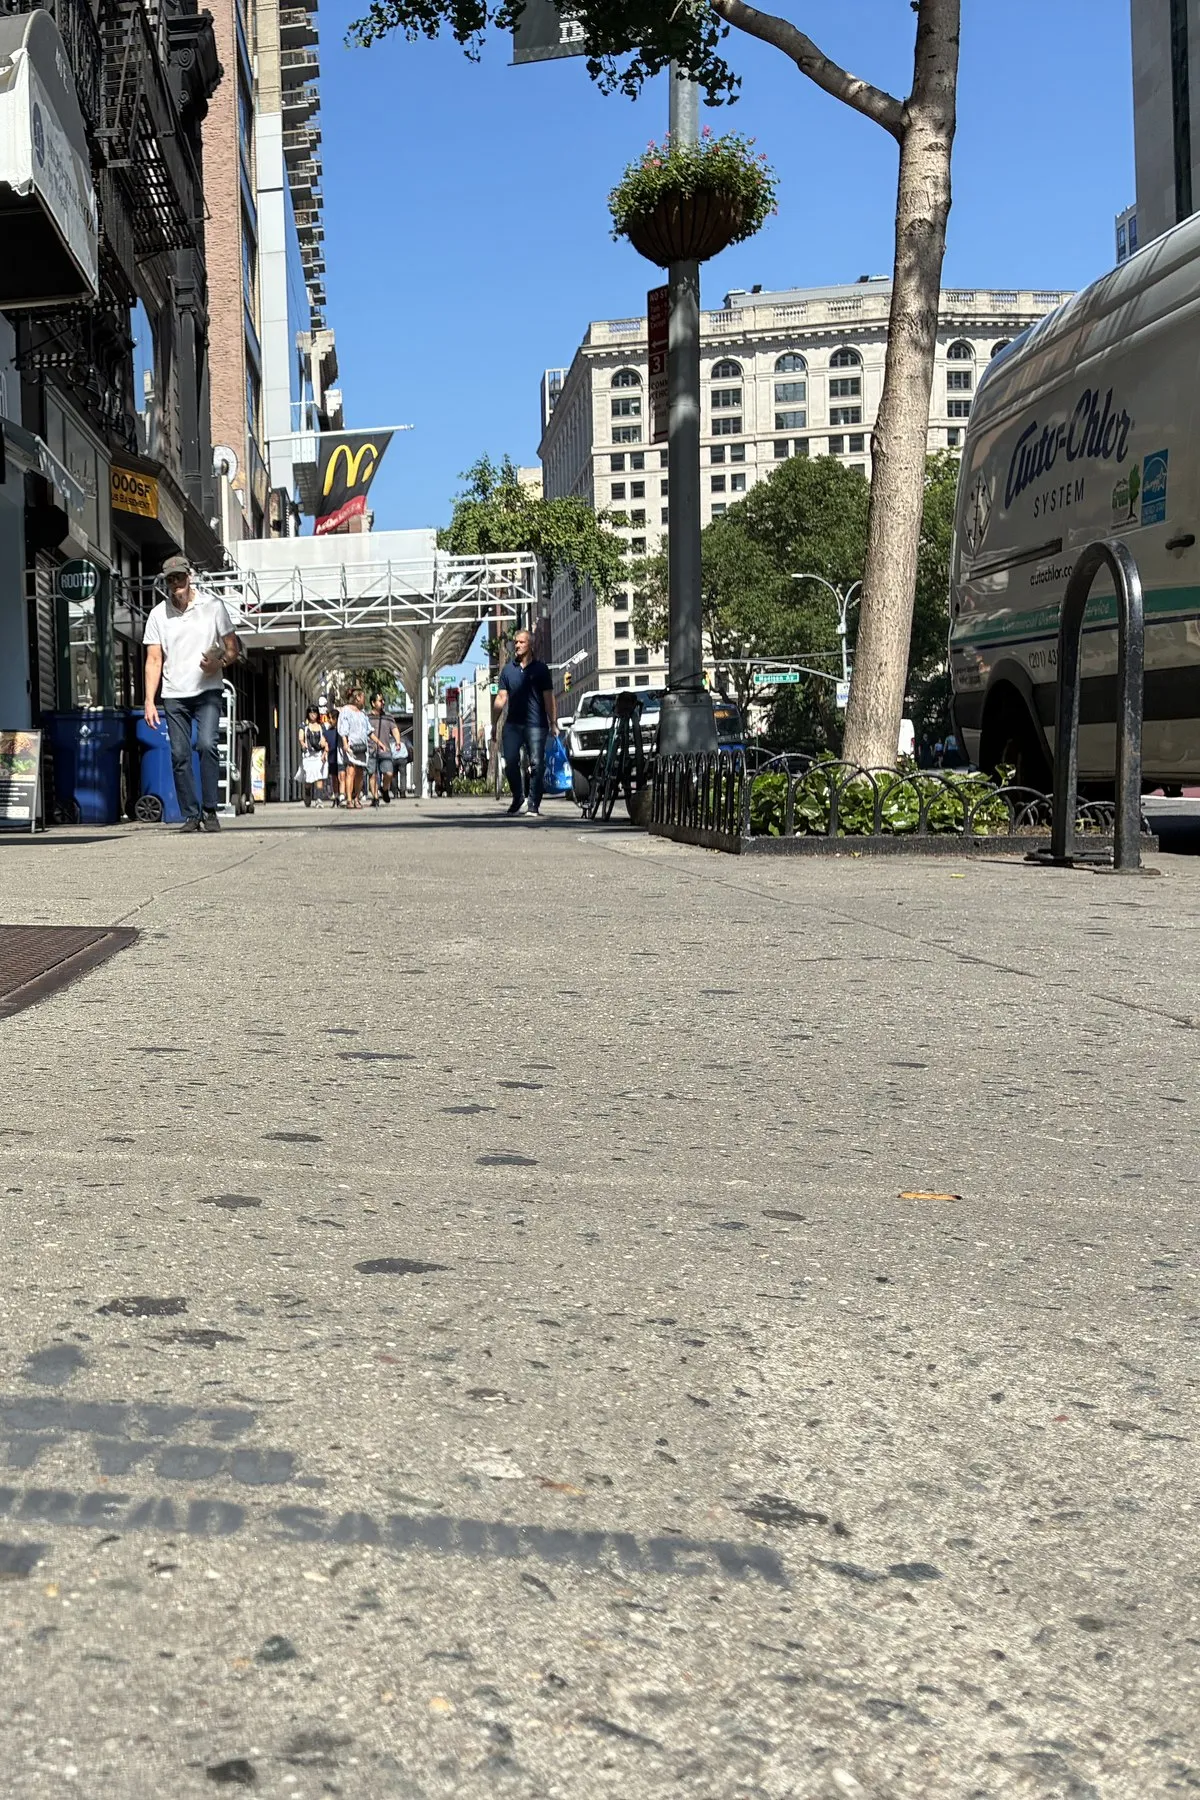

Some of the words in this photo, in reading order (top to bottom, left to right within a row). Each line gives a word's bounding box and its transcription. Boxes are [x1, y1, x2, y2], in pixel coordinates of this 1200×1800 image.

[559, 20, 585, 44] IB
[1033, 478, 1085, 519] SYSTEM
[60, 572, 96, 588] ROOTED
[1030, 562, 1073, 587] autochlor.co
[1029, 650, 1047, 669] (201)
[268, 1506, 791, 1591] SANDWICH
